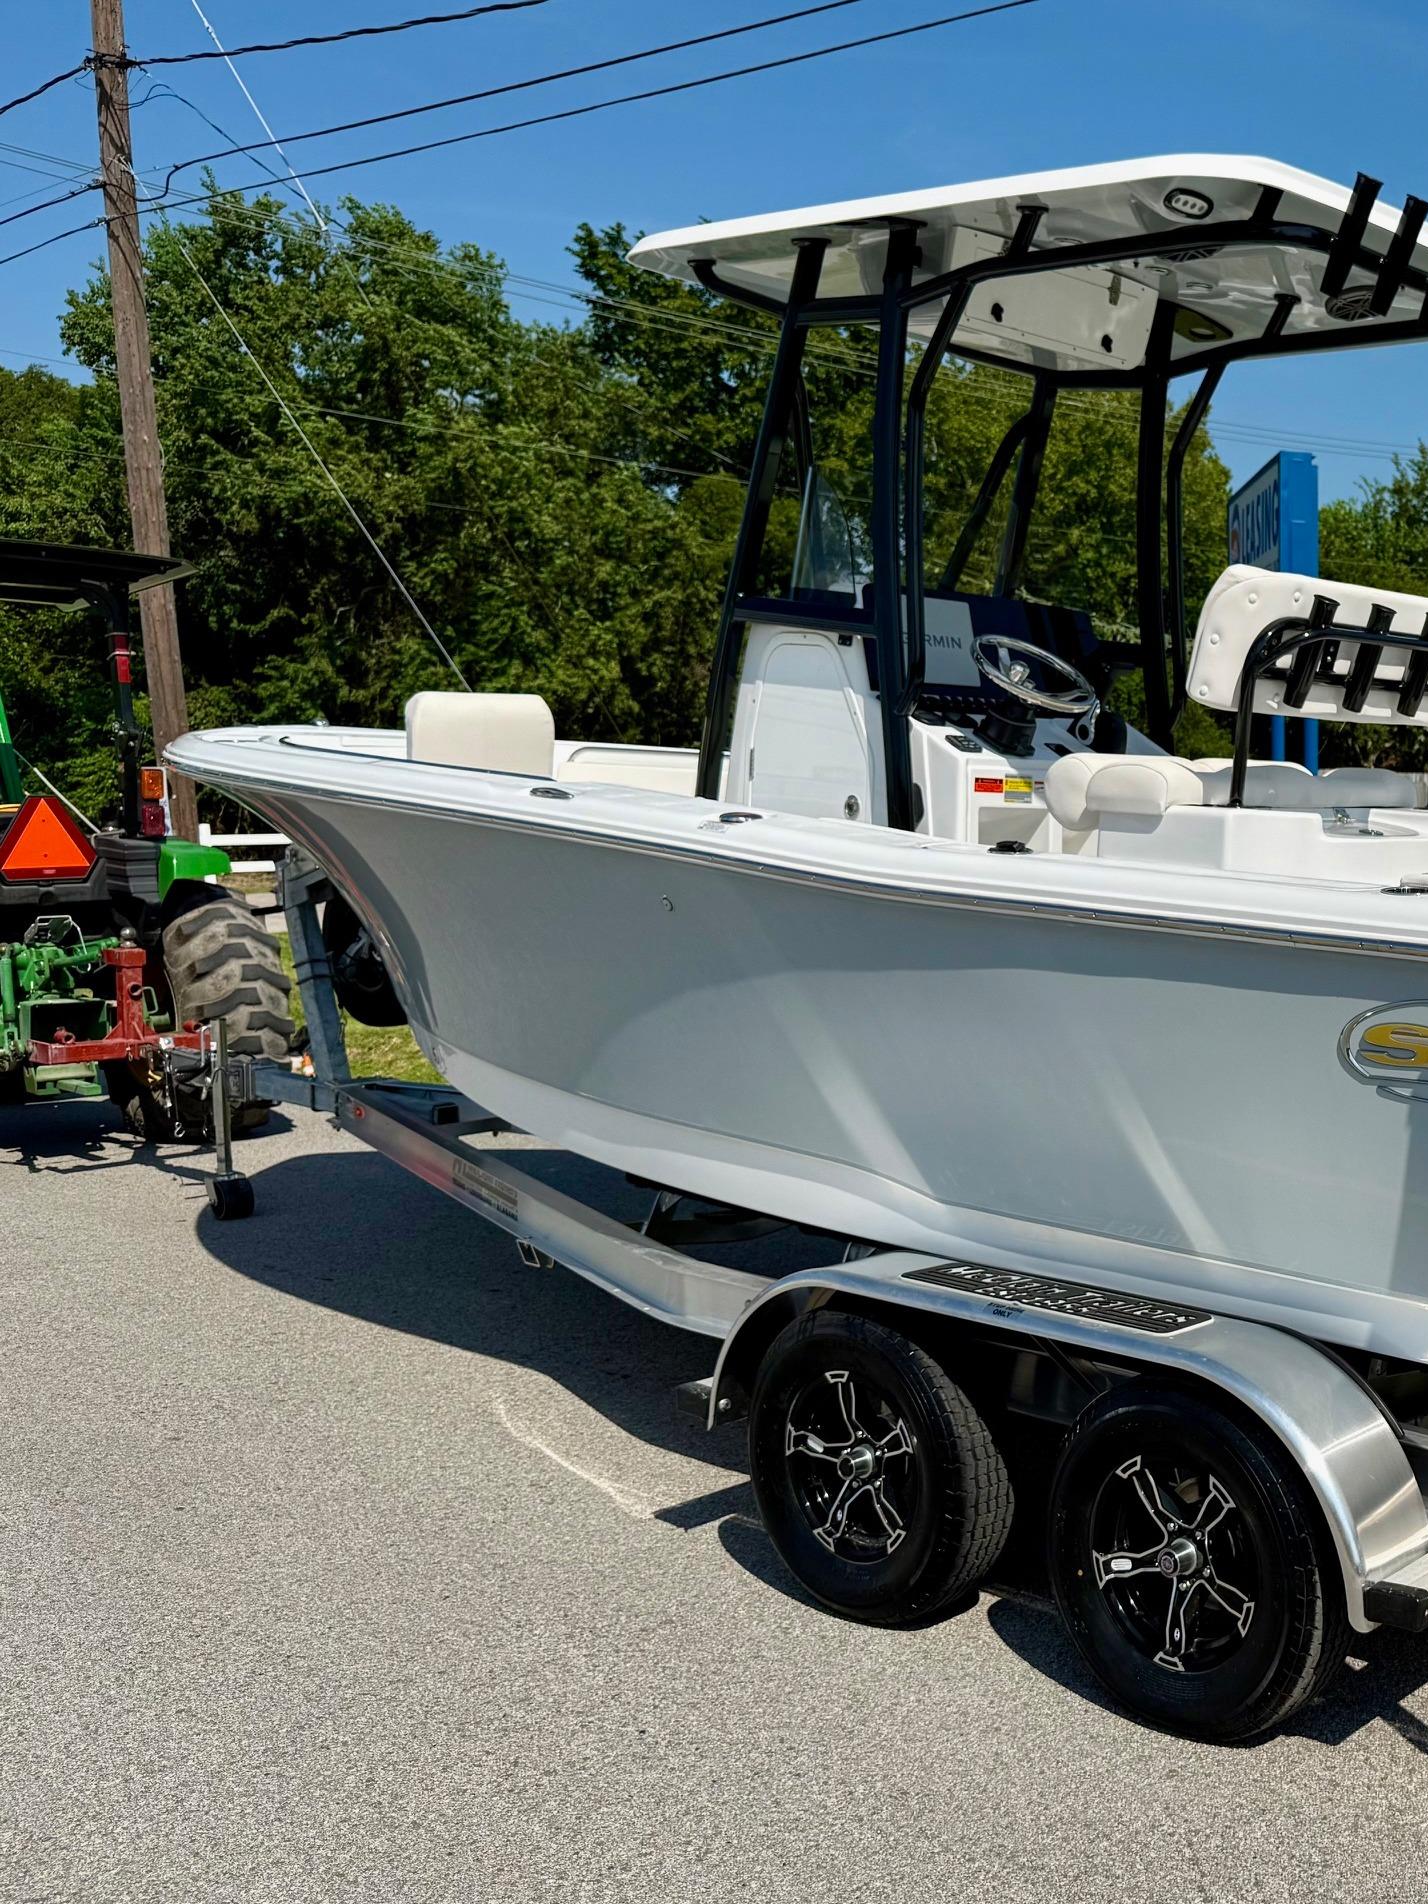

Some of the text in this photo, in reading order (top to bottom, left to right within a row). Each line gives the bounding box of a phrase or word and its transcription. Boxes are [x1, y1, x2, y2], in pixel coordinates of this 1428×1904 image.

[1241, 479, 1280, 564] LEASING
[940, 1266, 1196, 1323] McClain Trailers
[993, 1308, 1013, 1318] ONLY
